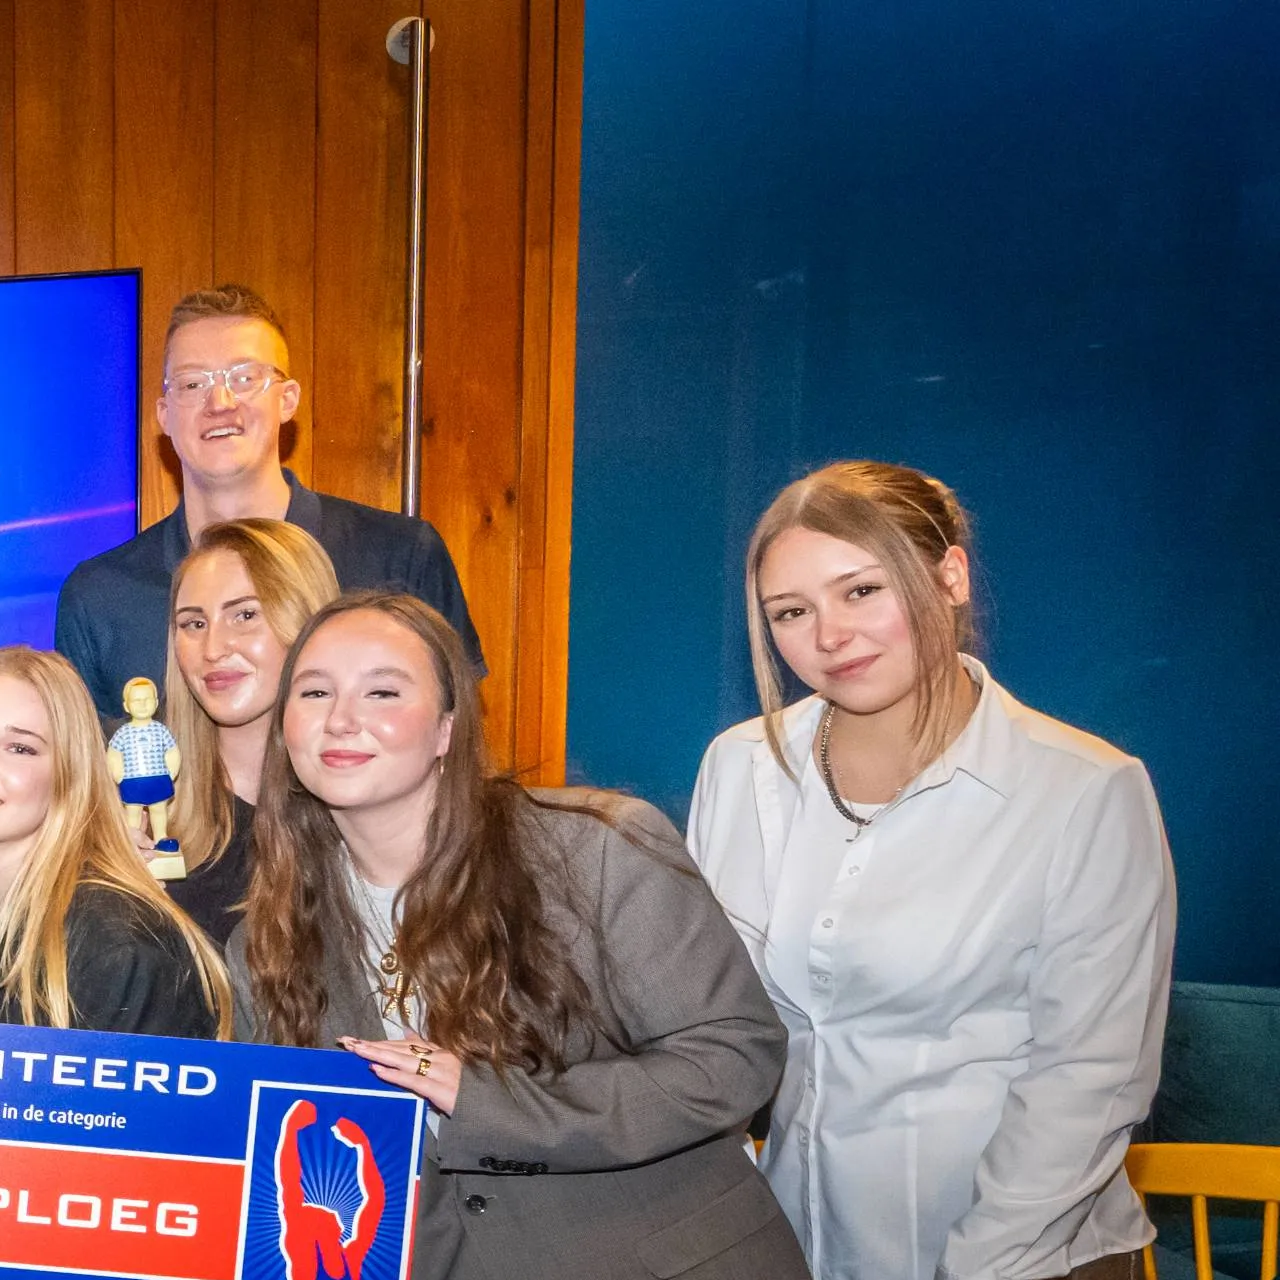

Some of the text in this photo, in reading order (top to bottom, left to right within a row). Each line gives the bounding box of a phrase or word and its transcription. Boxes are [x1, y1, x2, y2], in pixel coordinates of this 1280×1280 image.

[2, 1103, 18, 1120] in
[23, 1104, 44, 1122] de
[48, 1109, 127, 1130] categorie
